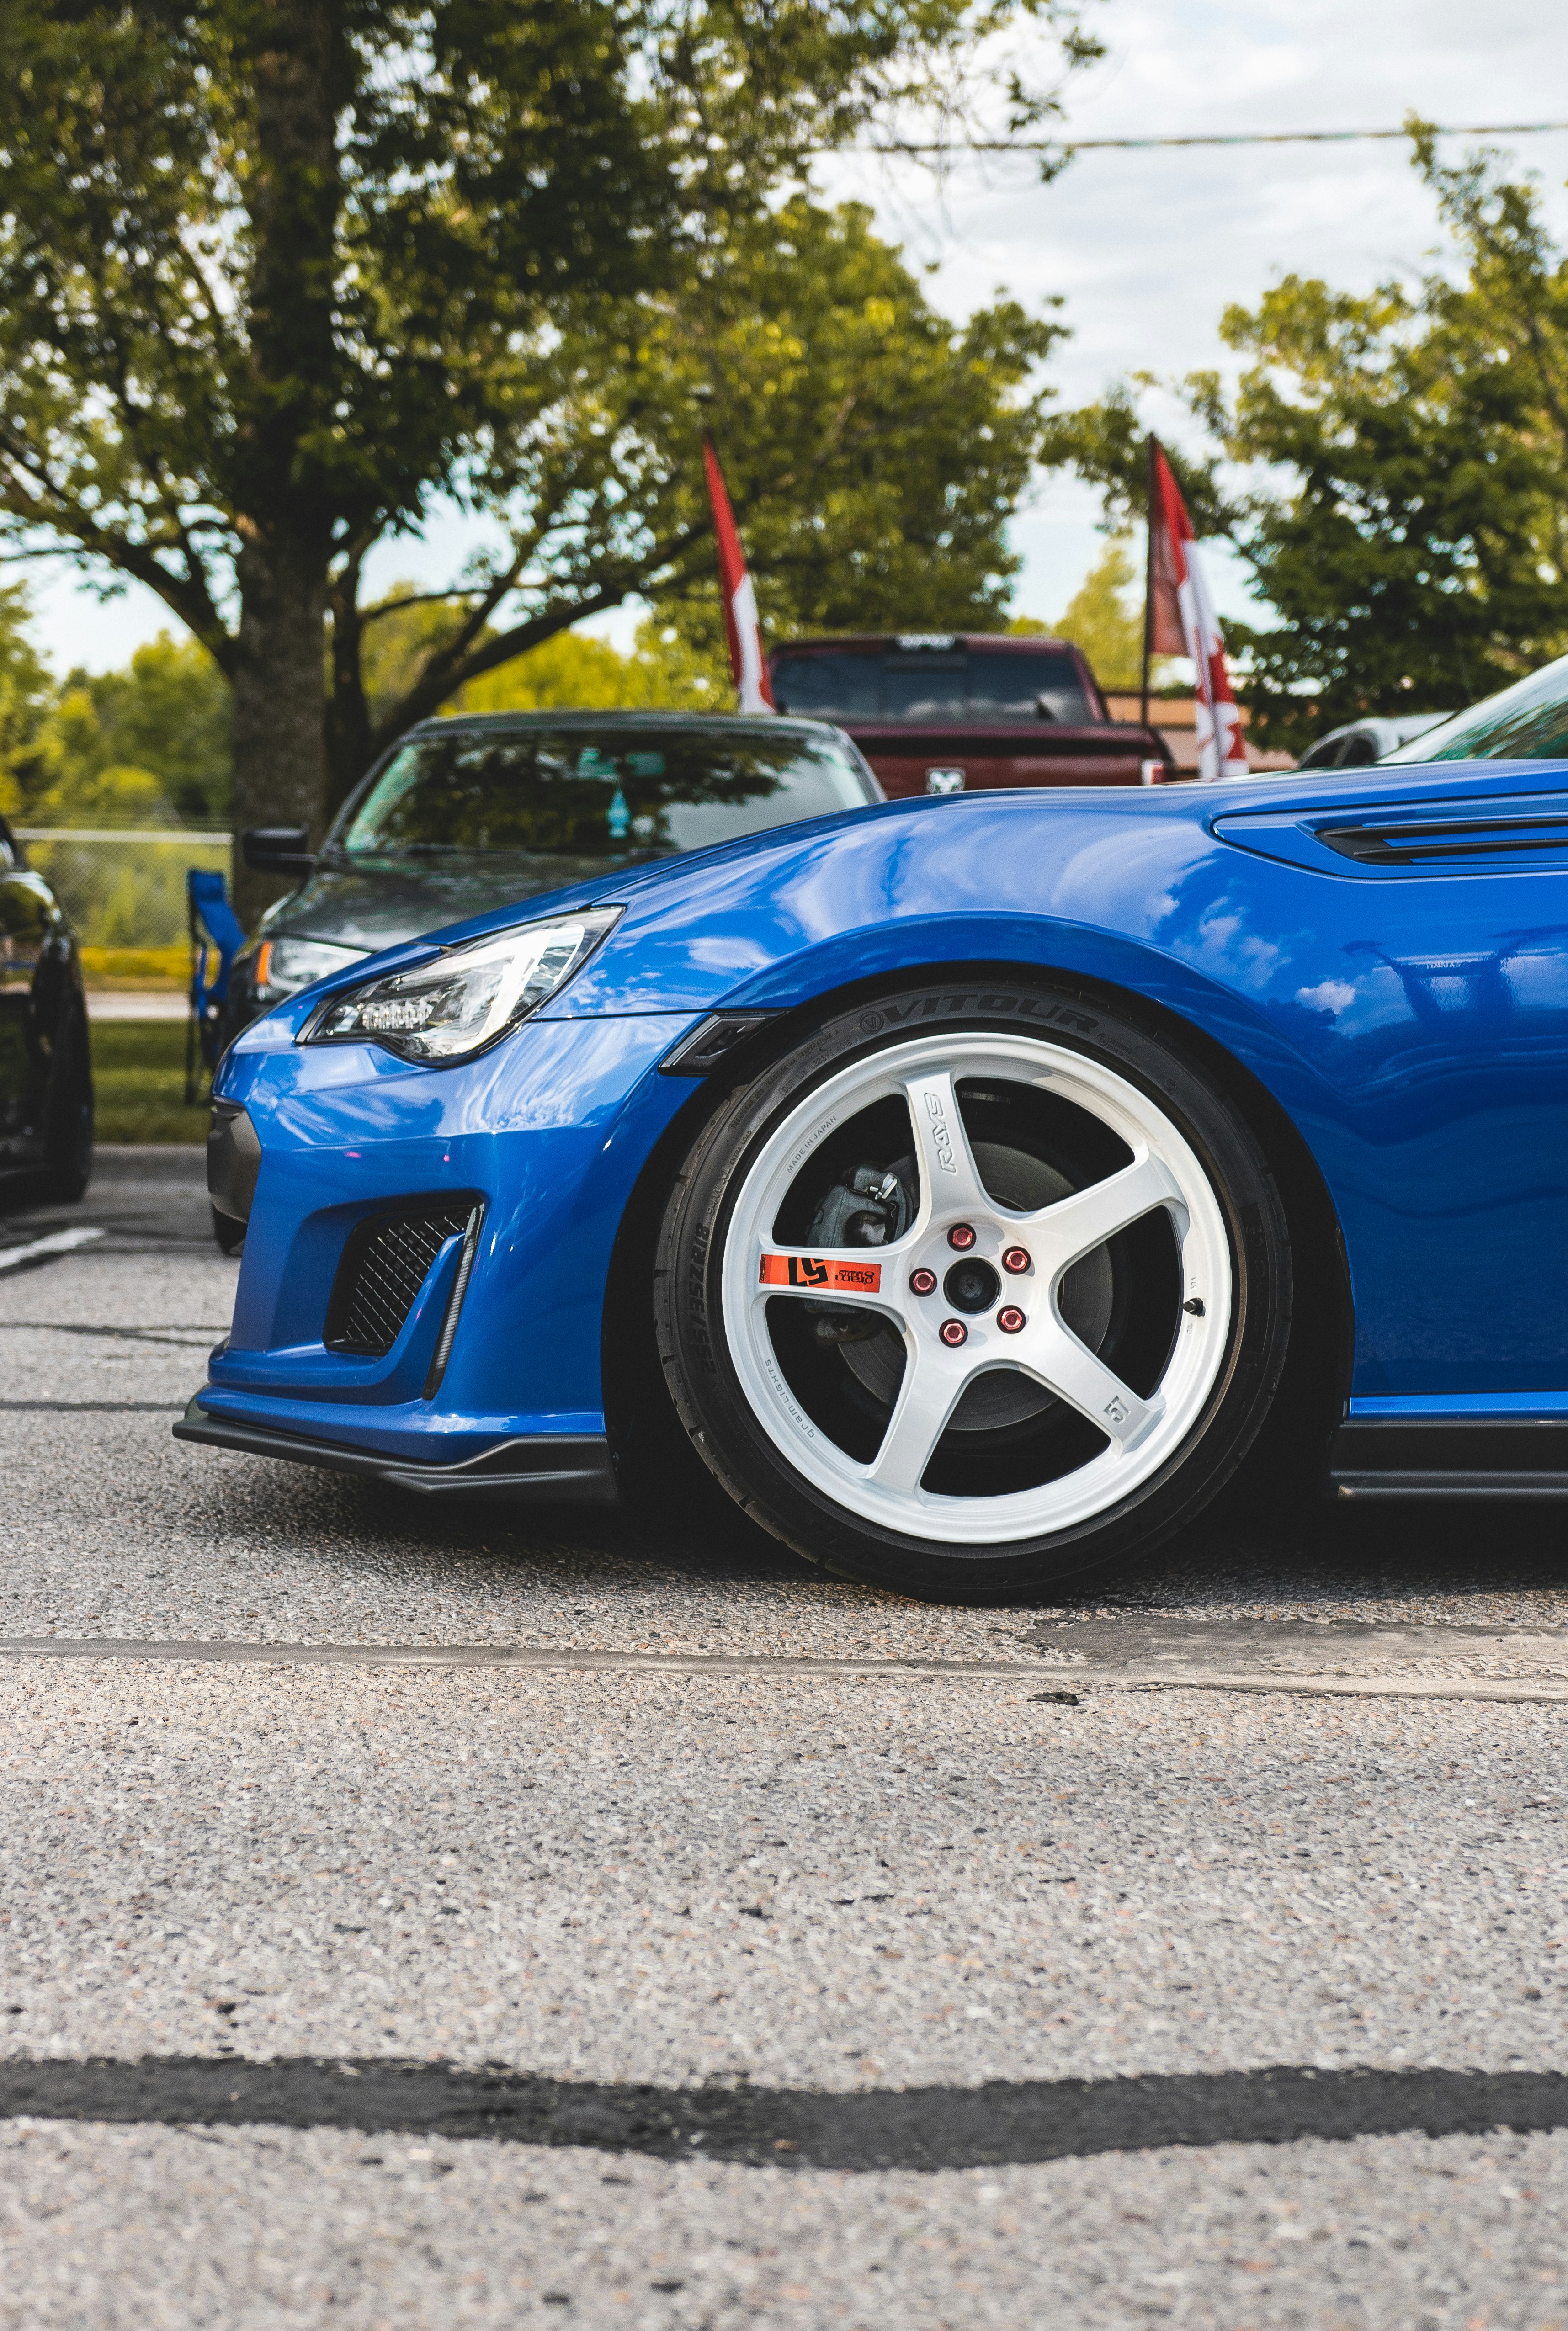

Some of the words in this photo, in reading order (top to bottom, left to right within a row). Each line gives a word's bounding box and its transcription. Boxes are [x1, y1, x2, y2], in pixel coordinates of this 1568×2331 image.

[883, 994, 1100, 1034] VITOUR
[787, 1148, 805, 1173] MADE
[804, 1139, 813, 1148] IN
[813, 1116, 837, 1139] JAPAN
[924, 1093, 957, 1174] RAYS
[706, 1187, 723, 1216] 94W
[718, 1166, 731, 1184] XL
[729, 1147, 742, 1165] EXTRA
[740, 1130, 753, 1145] LOAD
[788, 1257, 829, 1287] 57
[835, 1270, 874, 1284] gram
[689, 1221, 715, 1375] 255/35ZR18
[765, 1359, 789, 1404] LIGHTS
[788, 1405, 815, 1438] gram
[1103, 1395, 1131, 1424] 57
